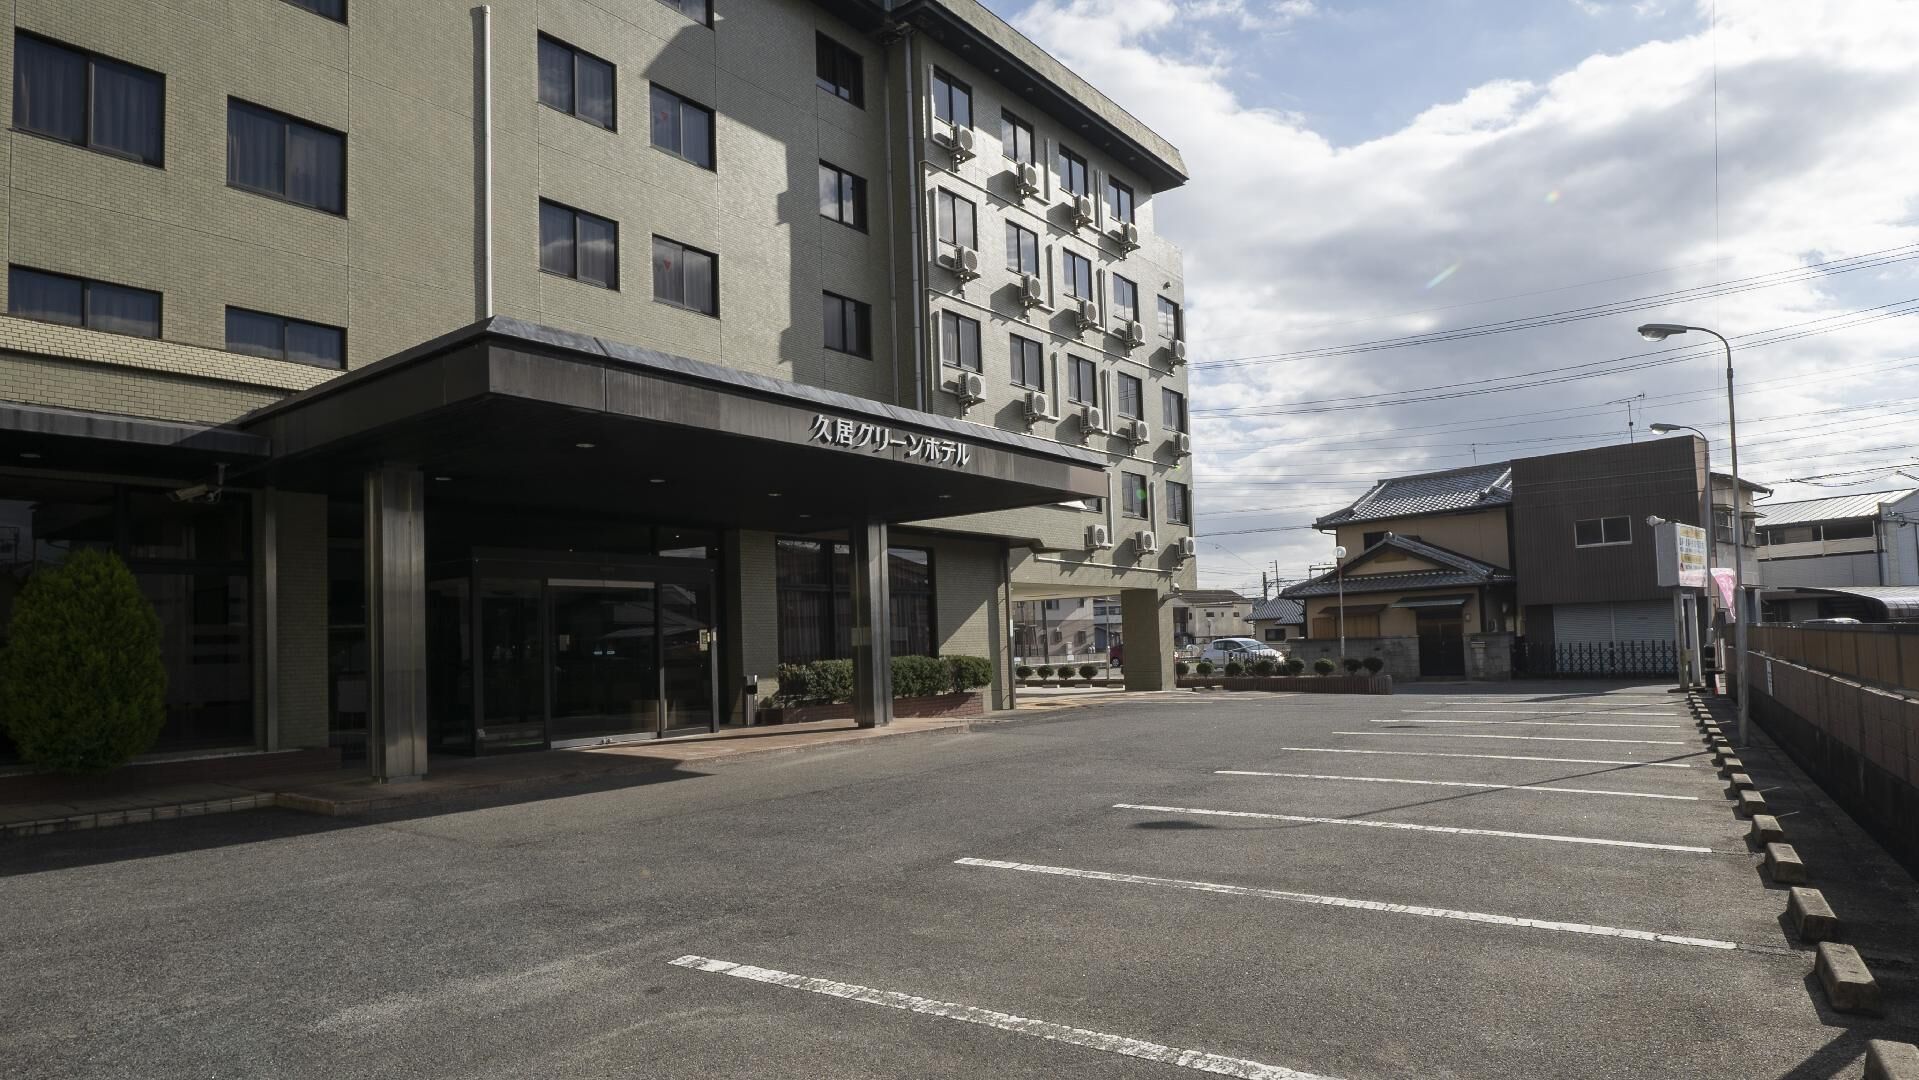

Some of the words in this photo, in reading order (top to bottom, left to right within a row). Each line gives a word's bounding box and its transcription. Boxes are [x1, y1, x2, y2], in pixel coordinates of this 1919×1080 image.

[813, 414, 971, 466] 久居グリーンホテル
